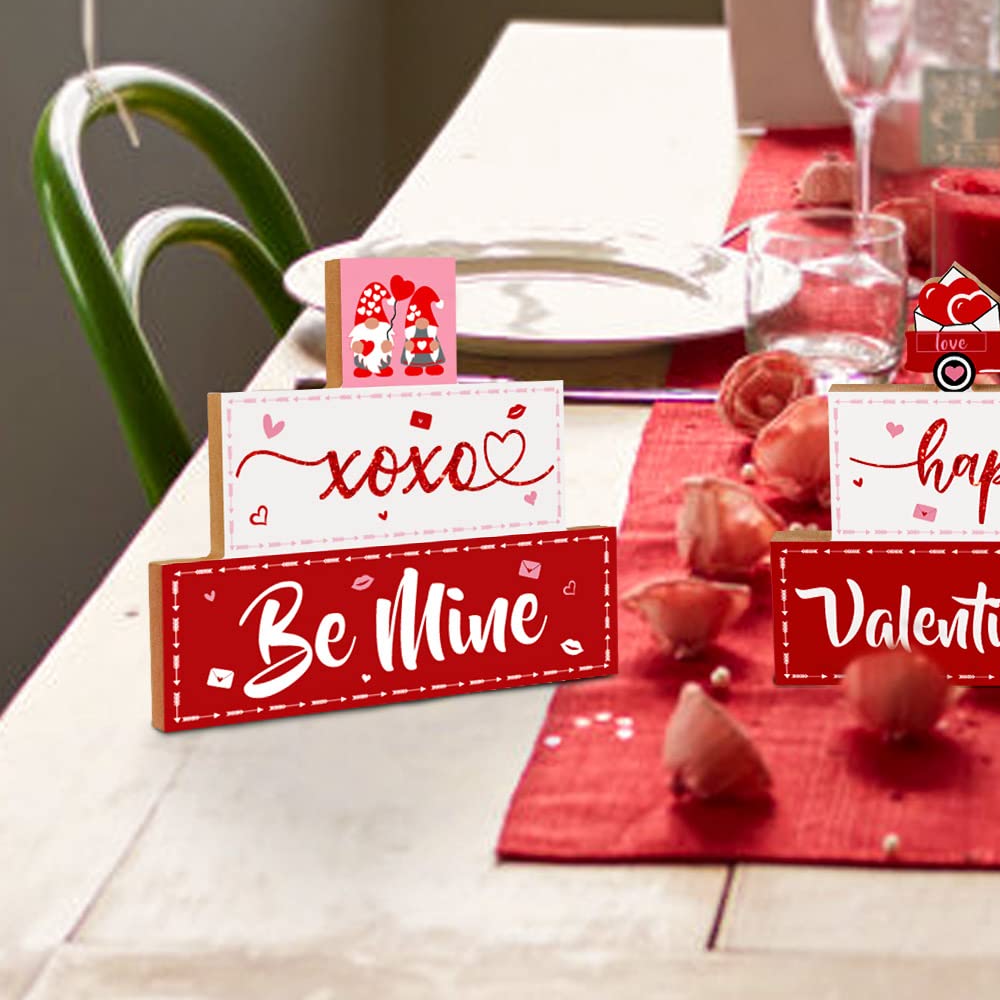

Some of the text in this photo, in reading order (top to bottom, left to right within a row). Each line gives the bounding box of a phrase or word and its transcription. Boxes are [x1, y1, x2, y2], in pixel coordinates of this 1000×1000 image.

[935, 333, 968, 351] love
[235, 441, 487, 501] xoxo
[239, 567, 548, 700] Be Mine
